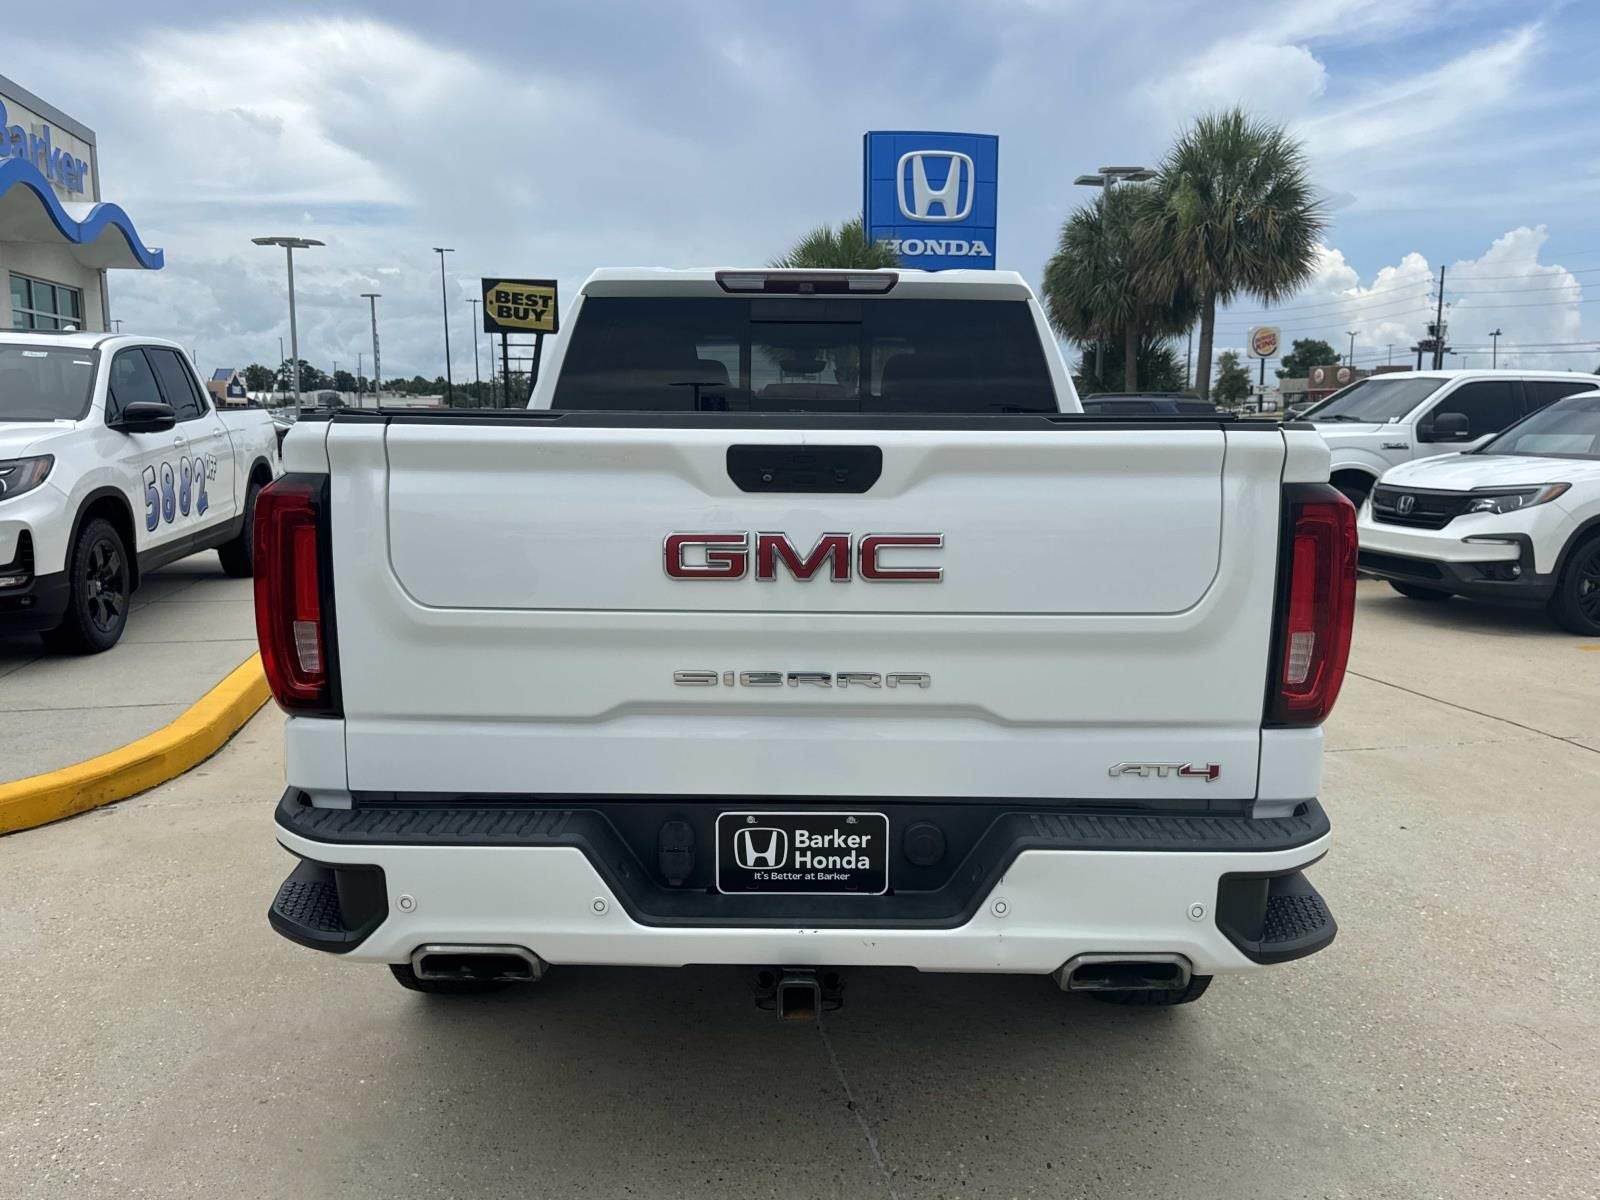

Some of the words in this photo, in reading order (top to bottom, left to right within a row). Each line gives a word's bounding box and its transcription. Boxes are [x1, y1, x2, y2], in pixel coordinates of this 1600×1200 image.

[876, 239, 992, 257] HONDA
[495, 290, 553, 309] BEST
[497, 305, 546, 322] BUY
[142, 456, 209, 532] 5882
[663, 531, 945, 583] GMC
[673, 670, 931, 689] SIERRA
[1109, 762, 1221, 783] AT4
[795, 829, 871, 848] Barker
[795, 850, 870, 869] Honda
[754, 872, 769, 880] It's
[771, 872, 802, 880] Better
[804, 872, 815, 880] at
[817, 872, 850, 880] Barker
